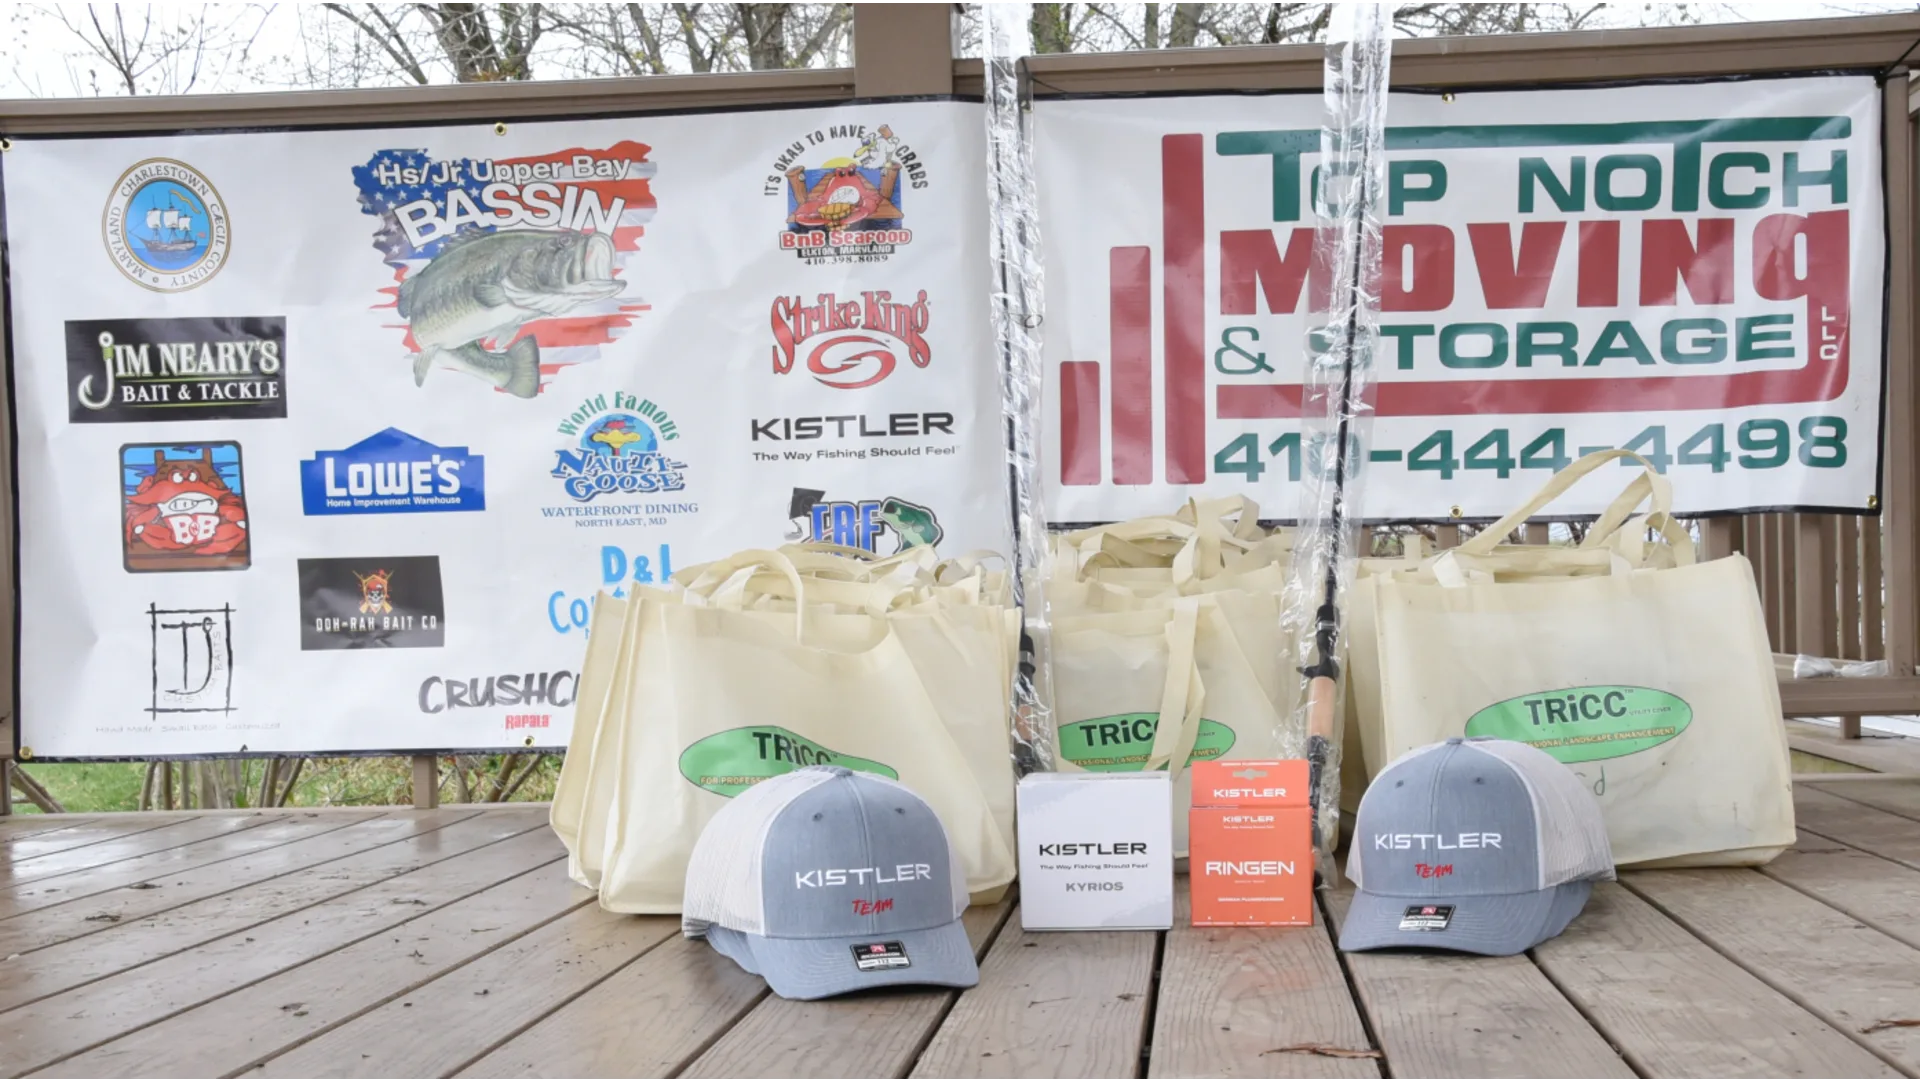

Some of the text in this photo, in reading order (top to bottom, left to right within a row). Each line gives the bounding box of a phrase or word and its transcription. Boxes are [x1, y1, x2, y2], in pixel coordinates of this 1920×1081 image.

[469, 157, 564, 184] Upper
[572, 154, 631, 181] Bay
[764, 124, 928, 196] IT'S OKAY TO HAVE CRABS
[1216, 124, 1848, 222] TOP NOTCH
[121, 165, 210, 198] CHARLESTOWN
[393, 181, 626, 250] BASSIN
[108, 206, 147, 278] MARYLAND
[840, 244, 892, 255] MARYLAND
[170, 251, 221, 287] COUNTY
[804, 255, 888, 266] 410.398.8089
[770, 289, 931, 375] Strike King
[1819, 306, 1840, 361] LLC
[1214, 326, 1275, 375] &
[78, 331, 280, 410] JIM NEARY'S
[121, 381, 280, 402] BAIT & TACKLE
[556, 390, 680, 441] World Famous
[751, 412, 956, 441] KISTLER
[752, 446, 956, 462] The Way Fishing Should Feel
[1214, 416, 1848, 483] 410-444-4498
[325, 454, 460, 497] LOWE'S
[564, 472, 686, 503] GOOSE
[326, 495, 461, 508] Home Improvement Warehouse
[541, 502, 698, 518] WATERFRONT DINING
[575, 518, 613, 528] NORTH
[649, 516, 667, 526] MD
[315, 615, 437, 632] OOH-RAH BAIT CO
[418, 670, 580, 714] CRUSHC
[1079, 719, 1159, 747] TRiC
[701, 776, 718, 785] FOR
[1213, 788, 1287, 798] KISTLER
[1223, 815, 1275, 823] KISTLER
[1039, 843, 1147, 856] KISTLER
[1375, 832, 1502, 850] KISTLER
[795, 863, 932, 889] KISTLER
[1205, 861, 1295, 876] RINGEN
[1415, 863, 1453, 878] TEAM
[1066, 881, 1124, 892] KYRIOS
[852, 898, 893, 916] TEAM
